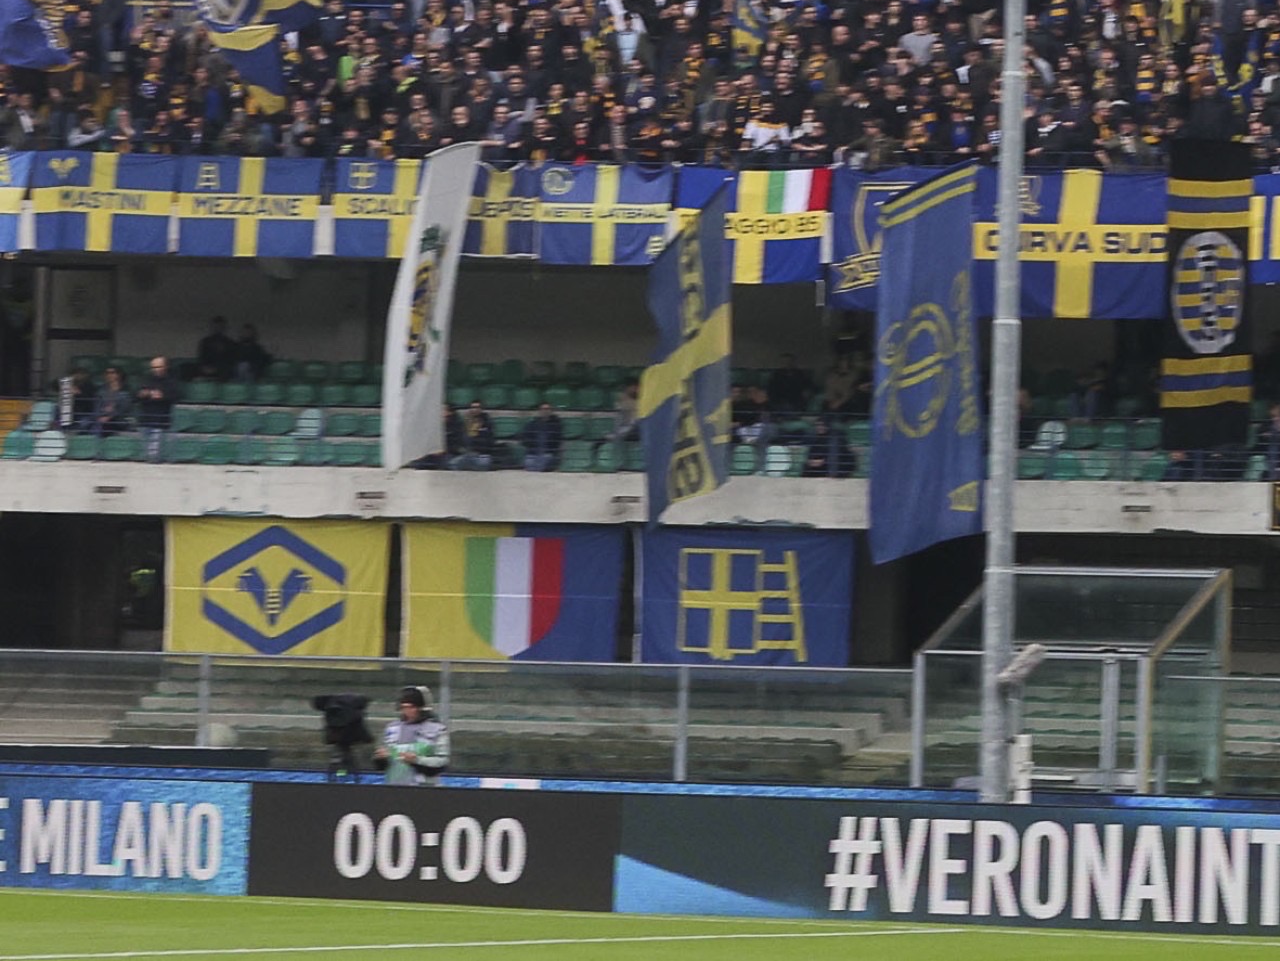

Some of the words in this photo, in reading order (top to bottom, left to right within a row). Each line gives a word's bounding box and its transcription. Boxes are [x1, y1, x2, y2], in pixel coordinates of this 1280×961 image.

[193, 197, 301, 216] MEZZANE
[347, 197, 416, 215] SCALI
[985, 229, 1095, 254] CRVA
[21, 797, 221, 881] MILANO
[333, 812, 527, 885] 00:00
